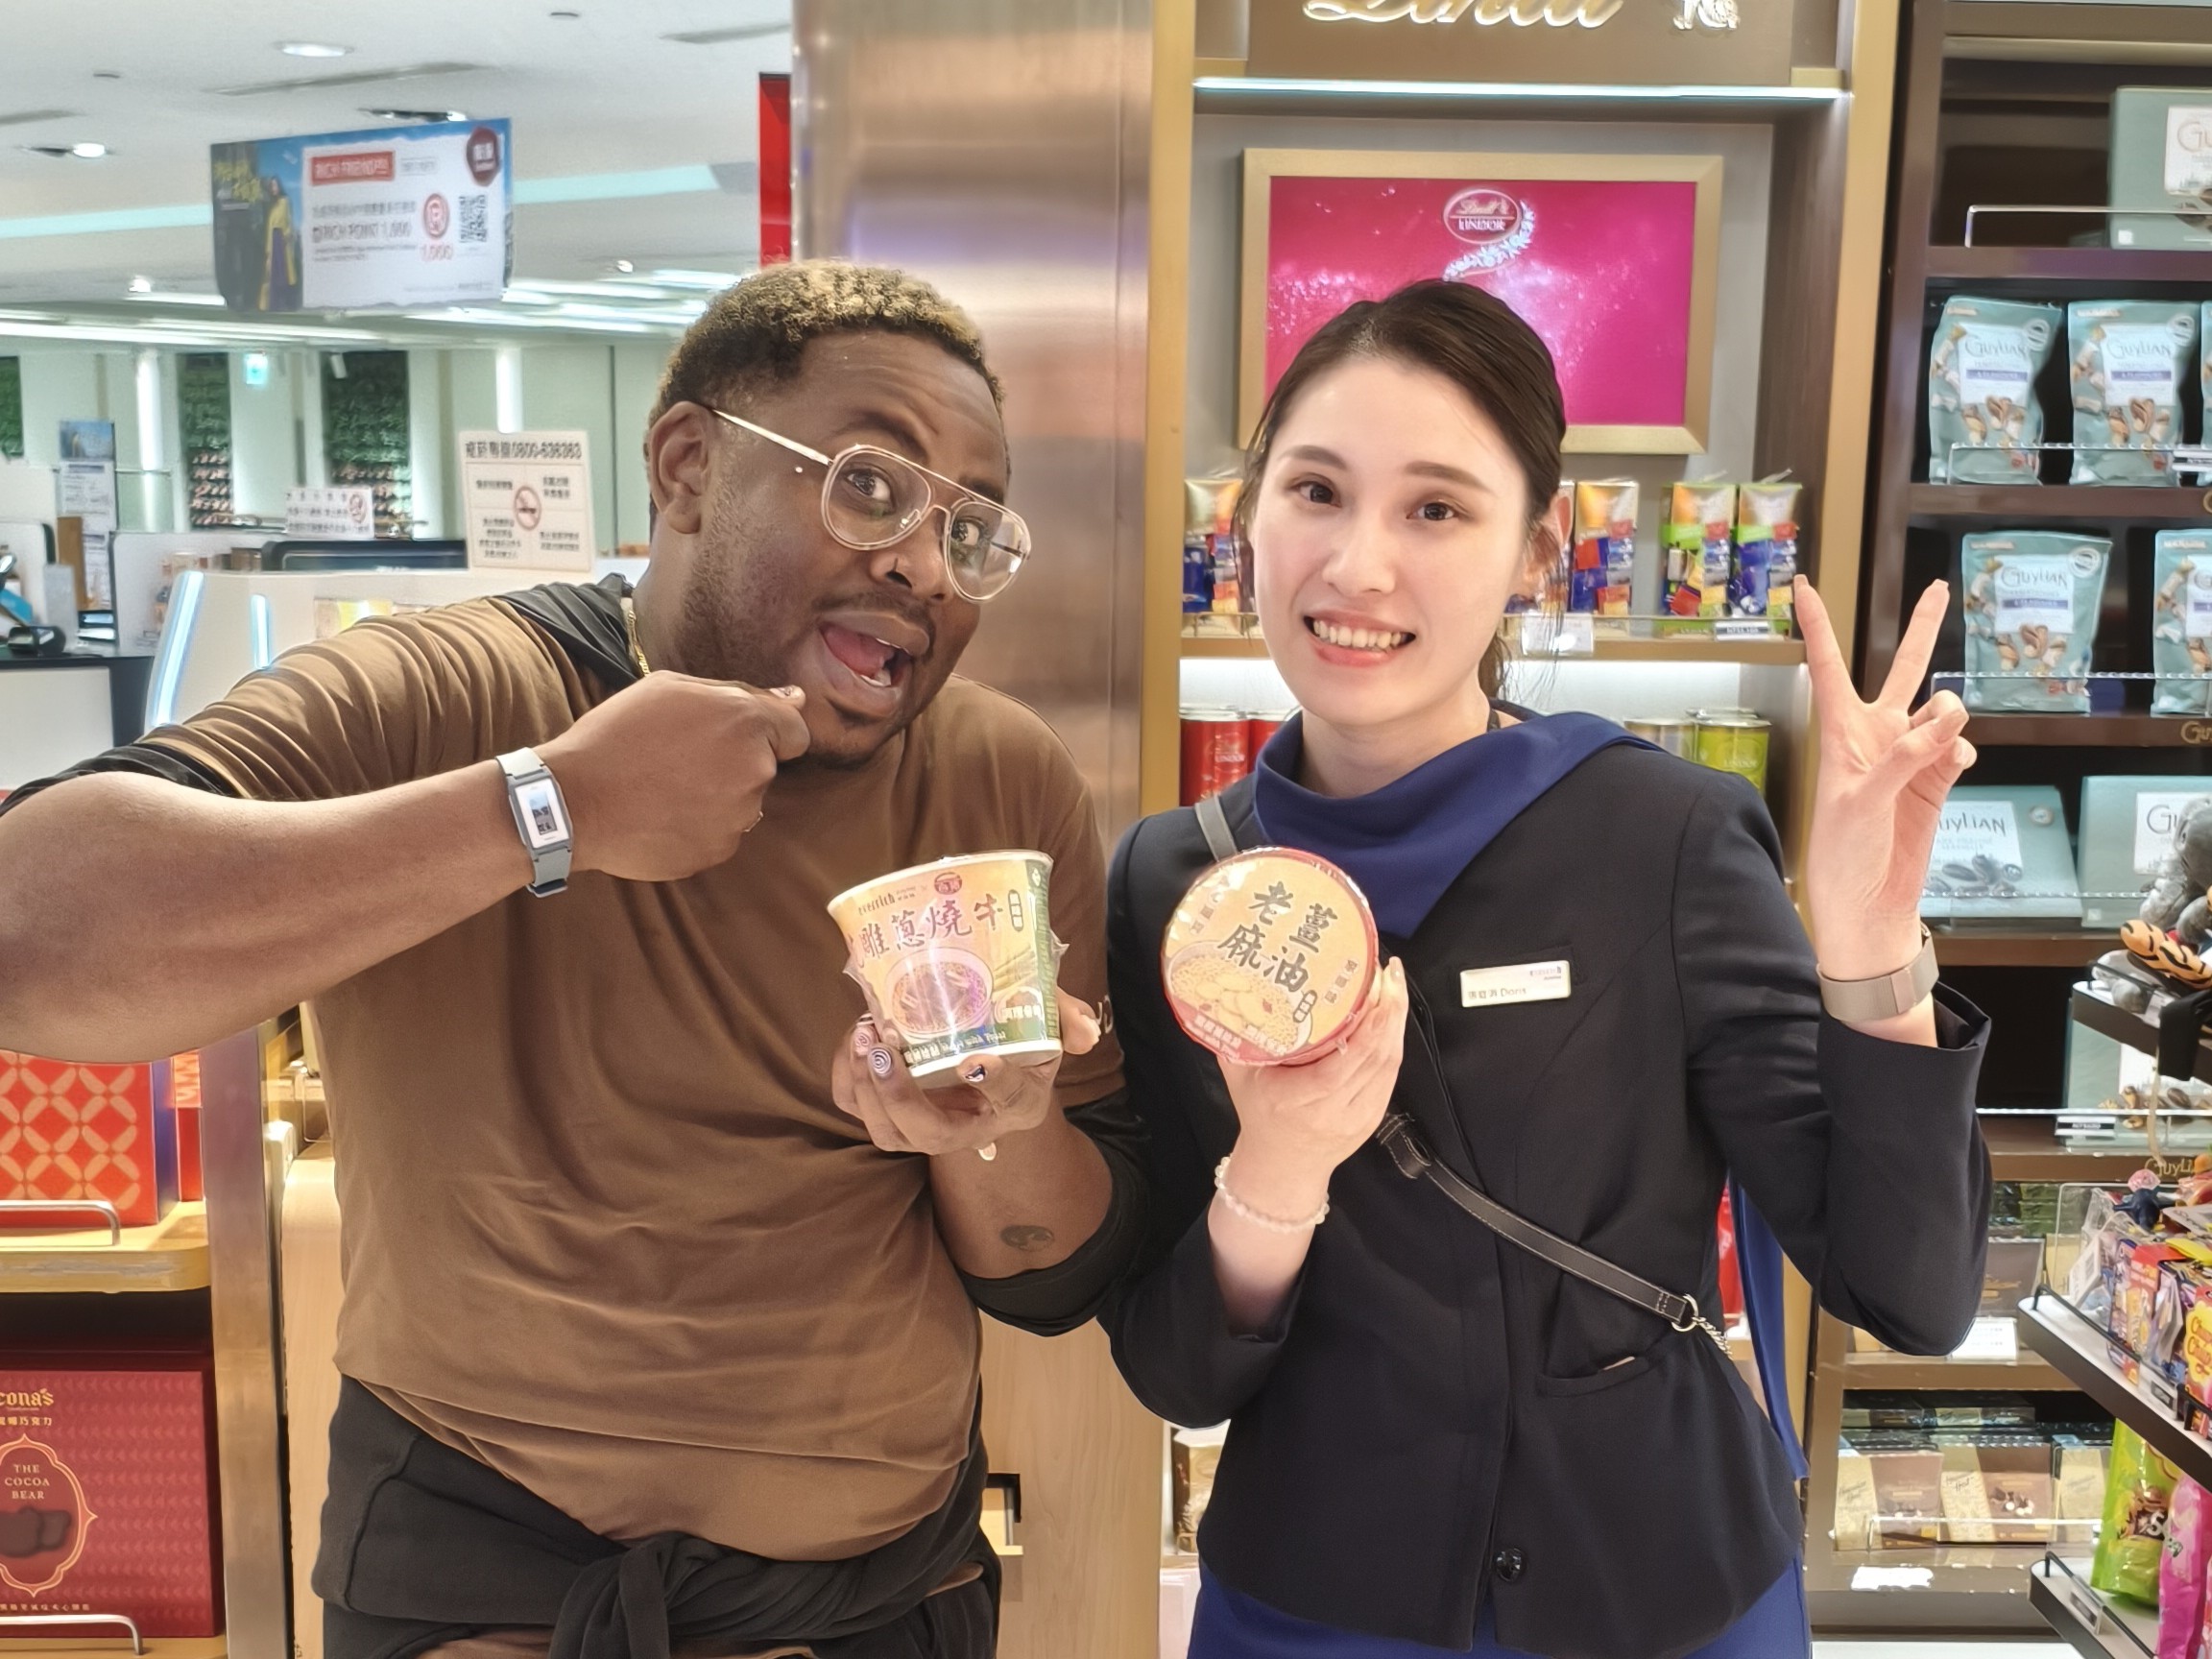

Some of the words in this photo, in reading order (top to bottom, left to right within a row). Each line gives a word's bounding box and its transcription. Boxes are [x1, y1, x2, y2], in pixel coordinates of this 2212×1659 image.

[1458, 218, 1505, 231] LINDOR
[12, 1464, 40, 1474] THE
[4, 1478, 51, 1487] COCOA
[12, 1490, 45, 1500] BEAR
